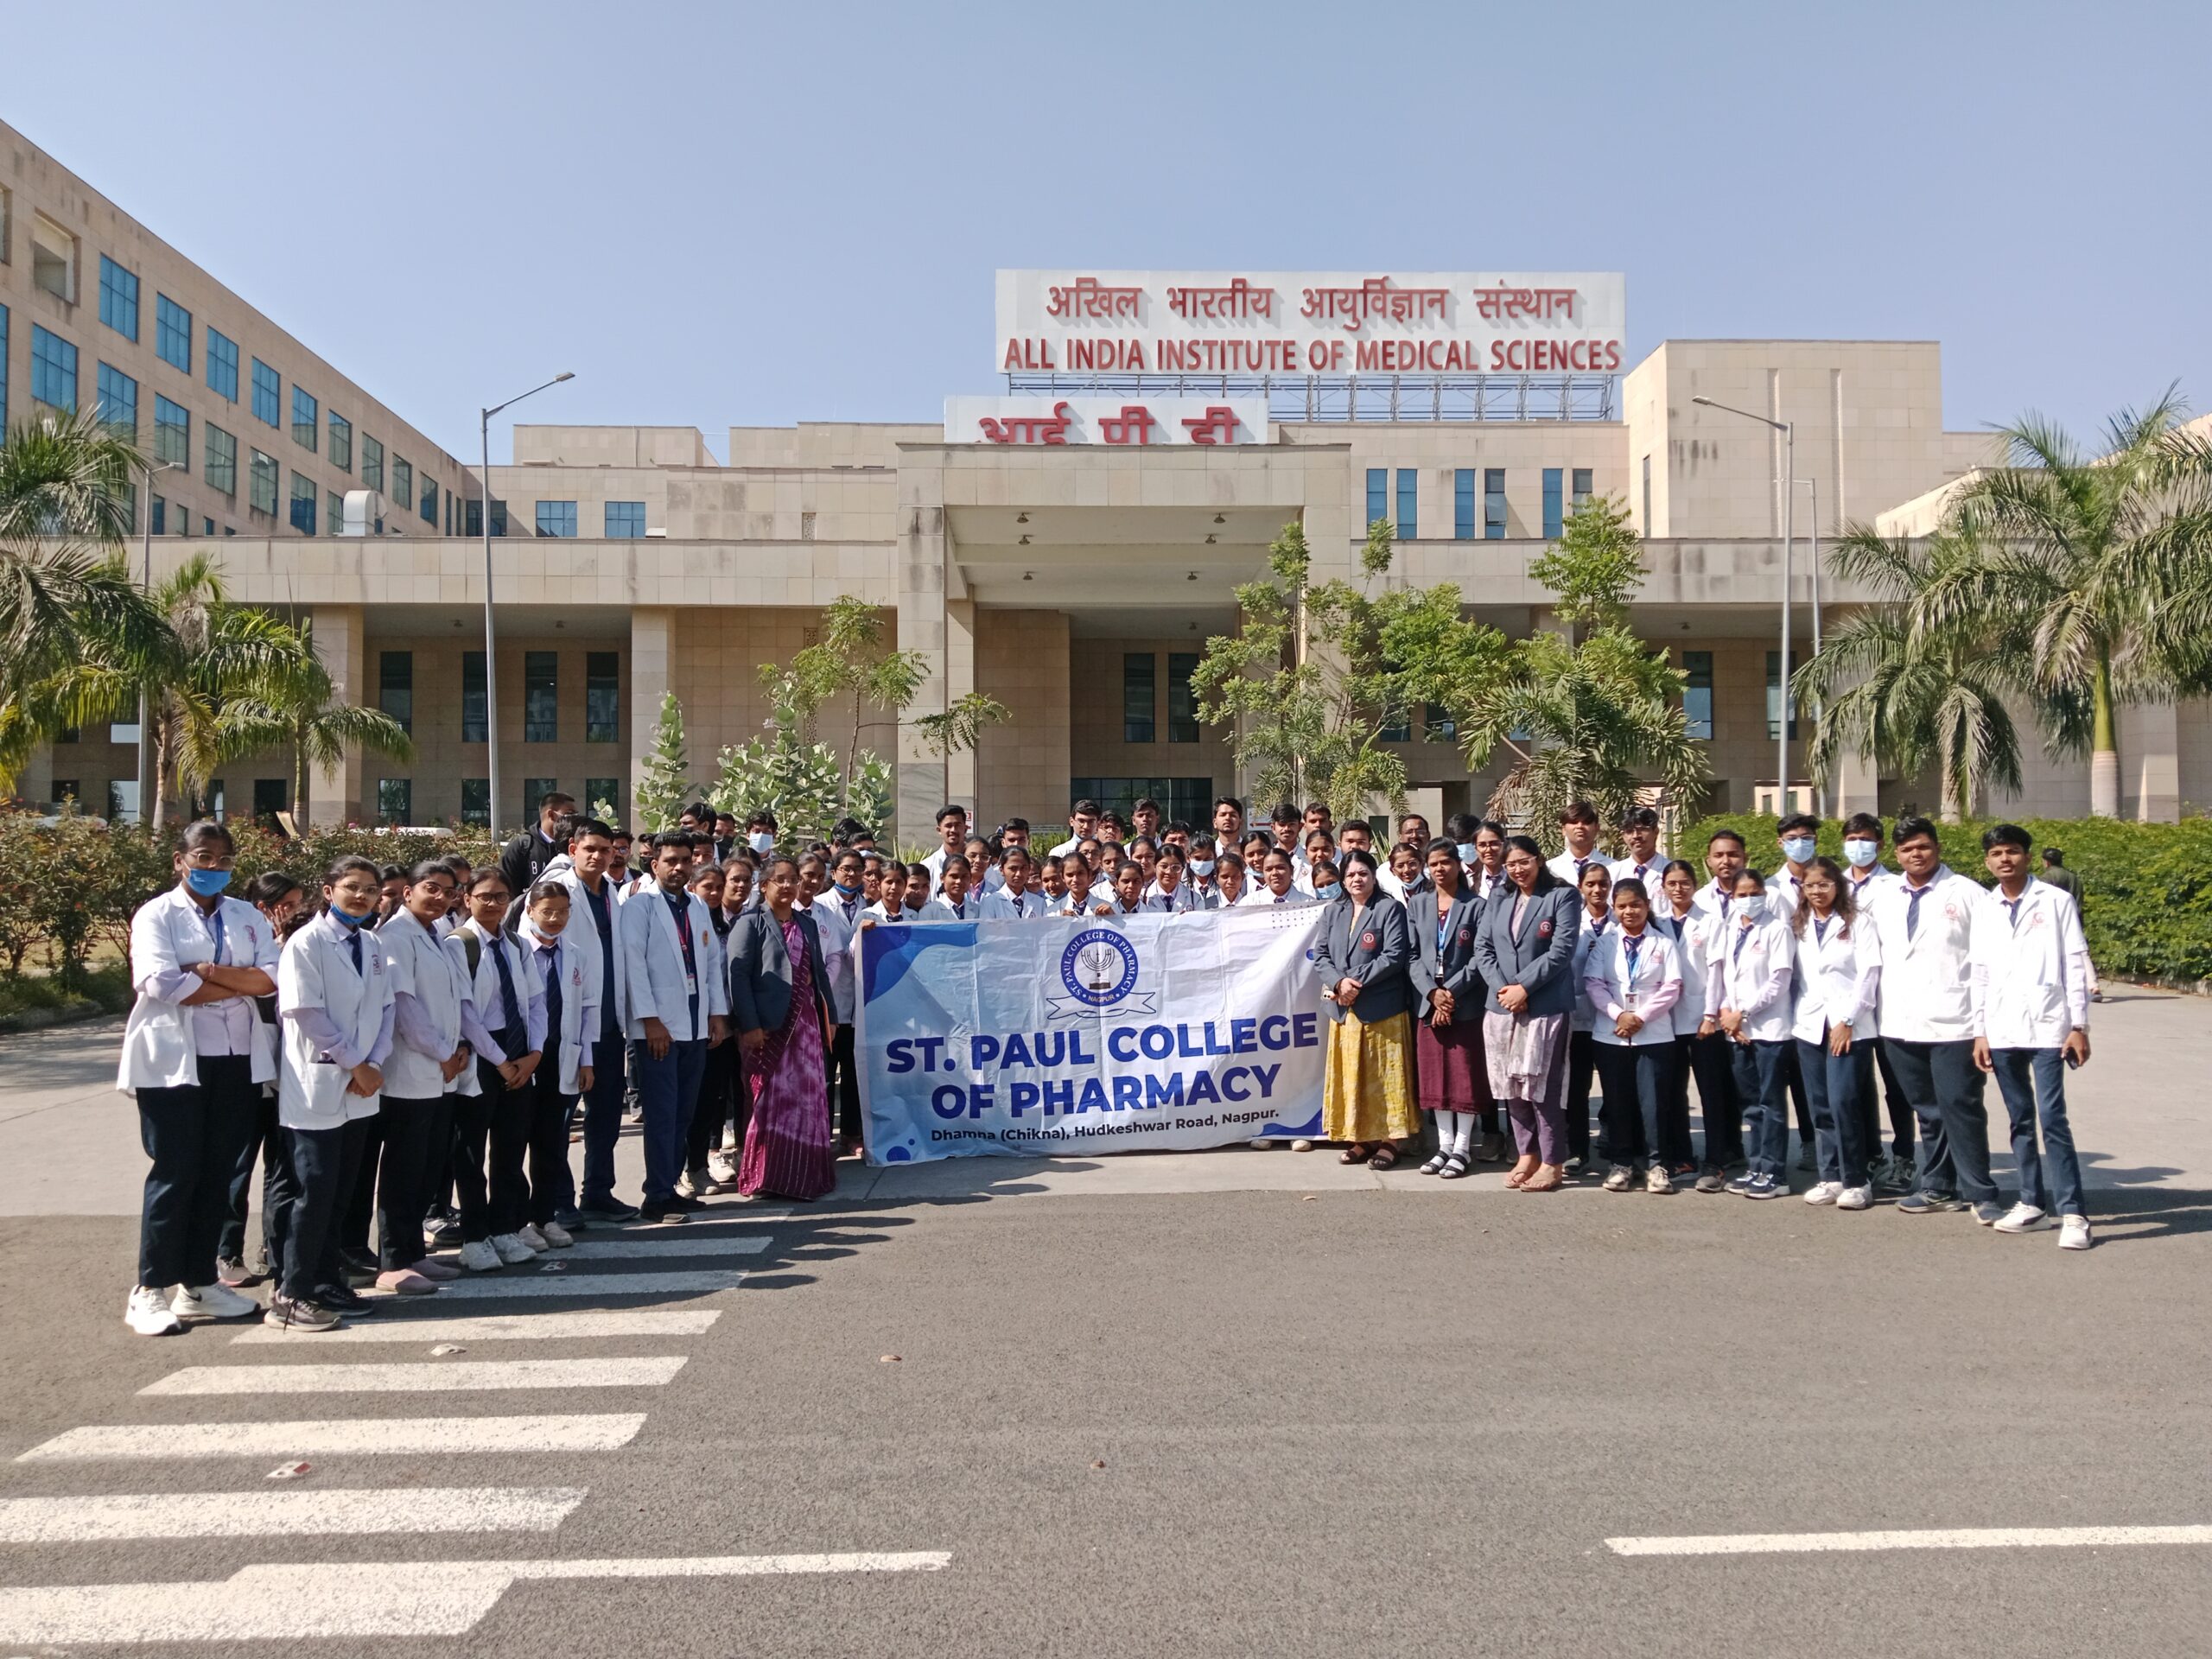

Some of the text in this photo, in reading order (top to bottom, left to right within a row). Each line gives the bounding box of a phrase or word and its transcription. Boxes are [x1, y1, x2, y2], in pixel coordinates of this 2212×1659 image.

[1046, 276, 1576, 332] अखिल भारतीय आयुर्विज्ञान संस्थान
[1004, 338, 1620, 371] ALL INDIA INSTITUTE OF MEDICAL SCIENCES
[1066, 931, 1105, 957] COLLEGE
[1107, 933, 1121, 944] OF
[1064, 958, 1073, 983] PAUL
[1118, 941, 1135, 994] PHARMACY
[1088, 994, 1116, 1002] NAGPUR
[886, 1012, 1319, 1073] ST. PAUL COLLEGE
[931, 1063, 1282, 1119] OF PHARMACY
[1001, 1127, 1070, 1142] (Chikna),
[1074, 1121, 1172, 1137] Hudkeshwar
[1175, 1115, 1217, 1130] Road,
[1222, 1109, 1279, 1124] Nagpur.
